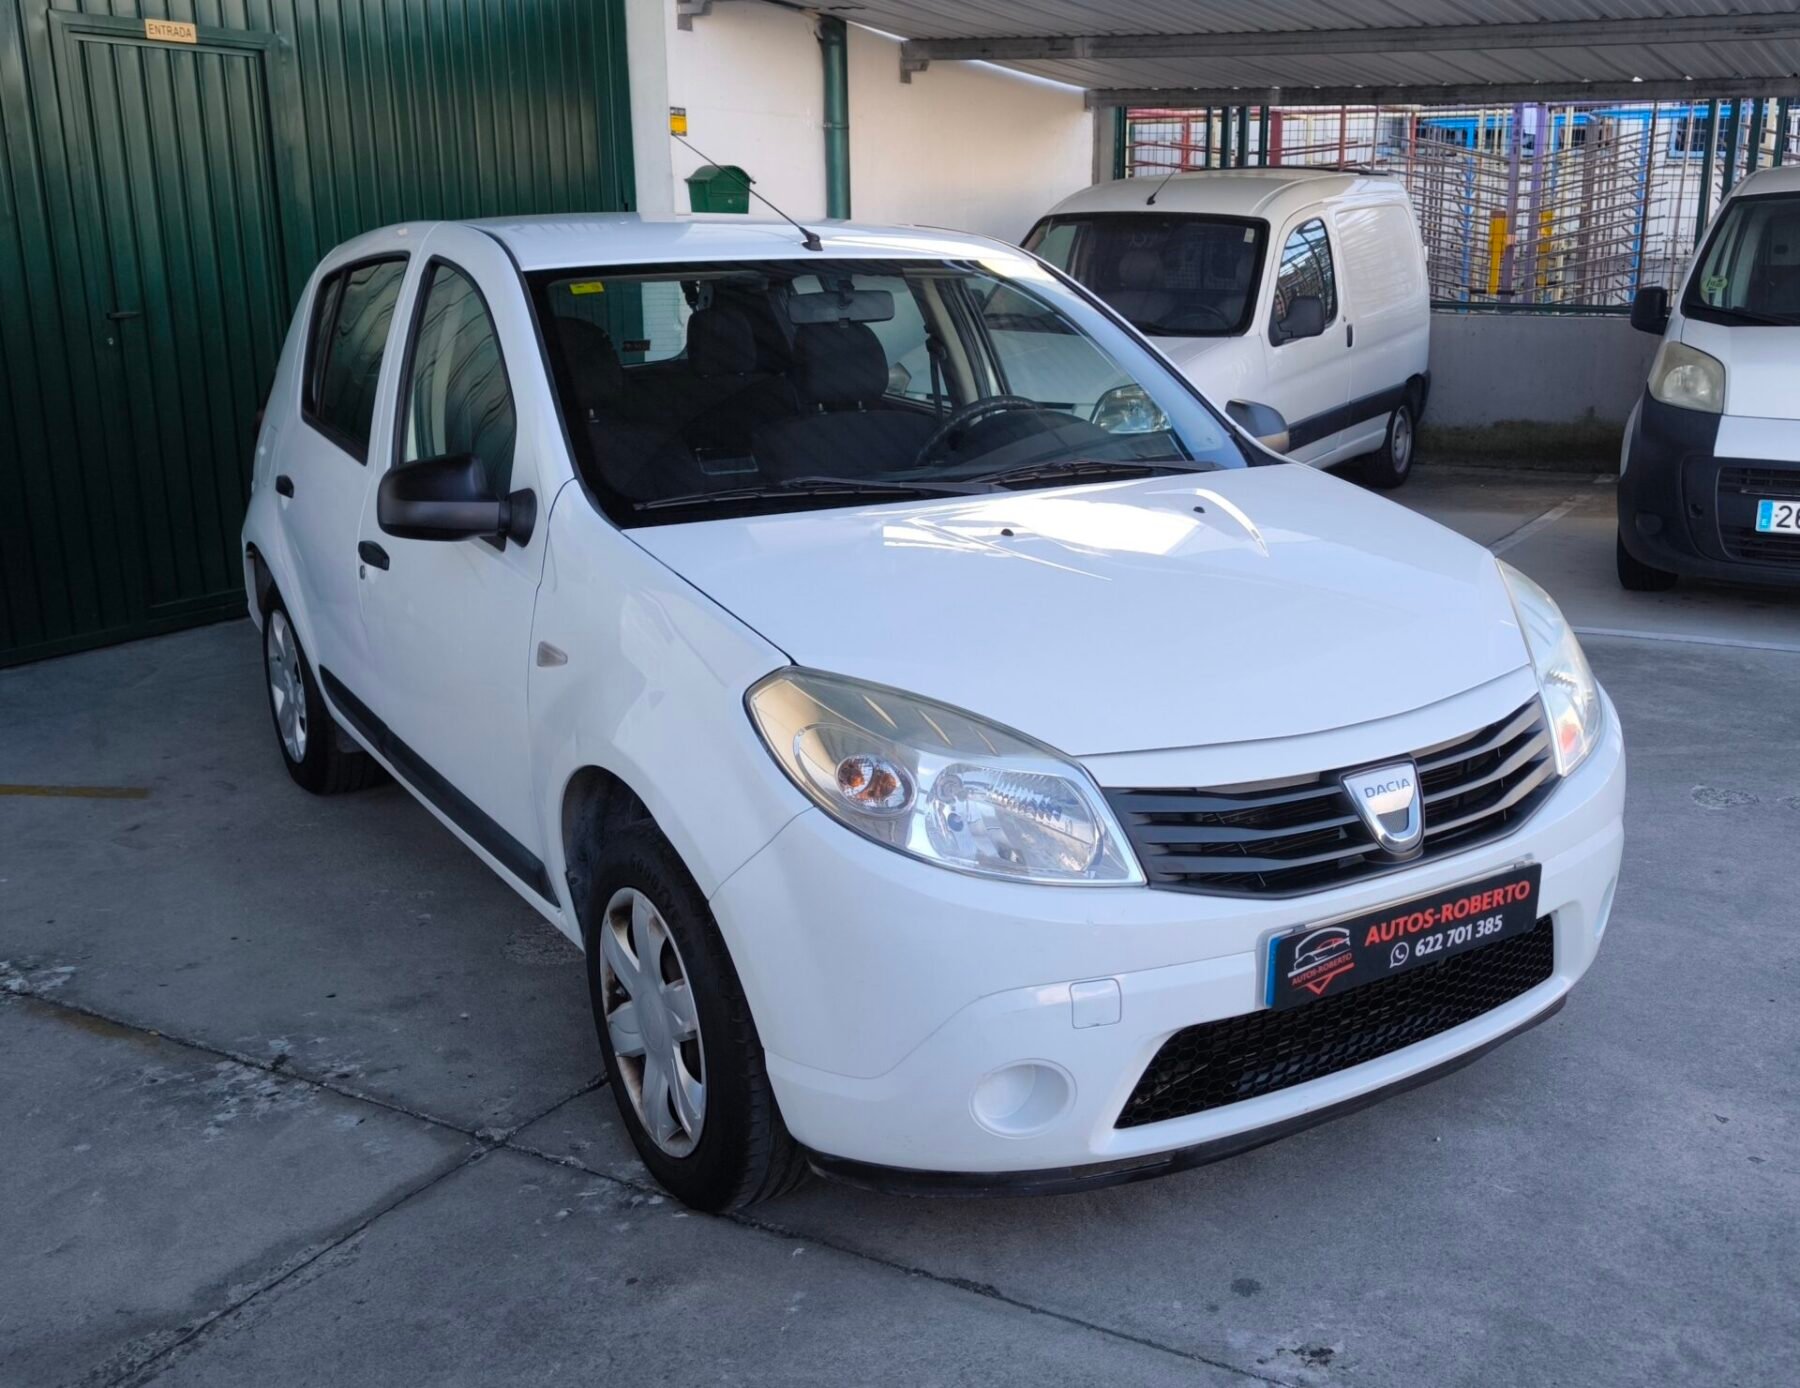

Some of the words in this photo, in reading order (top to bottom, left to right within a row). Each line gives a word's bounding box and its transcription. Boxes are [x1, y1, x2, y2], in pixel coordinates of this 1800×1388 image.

[148, 23, 192, 38] ENTRADA
[1364, 778, 1411, 798] DACIA
[1364, 880, 1531, 946] AUTOS-ROBERTO
[1415, 932, 1443, 957] 622
[1446, 923, 1472, 947] 701
[1476, 914, 1503, 938] 385
[1291, 952, 1352, 986] AUTOS-ROBERTO
